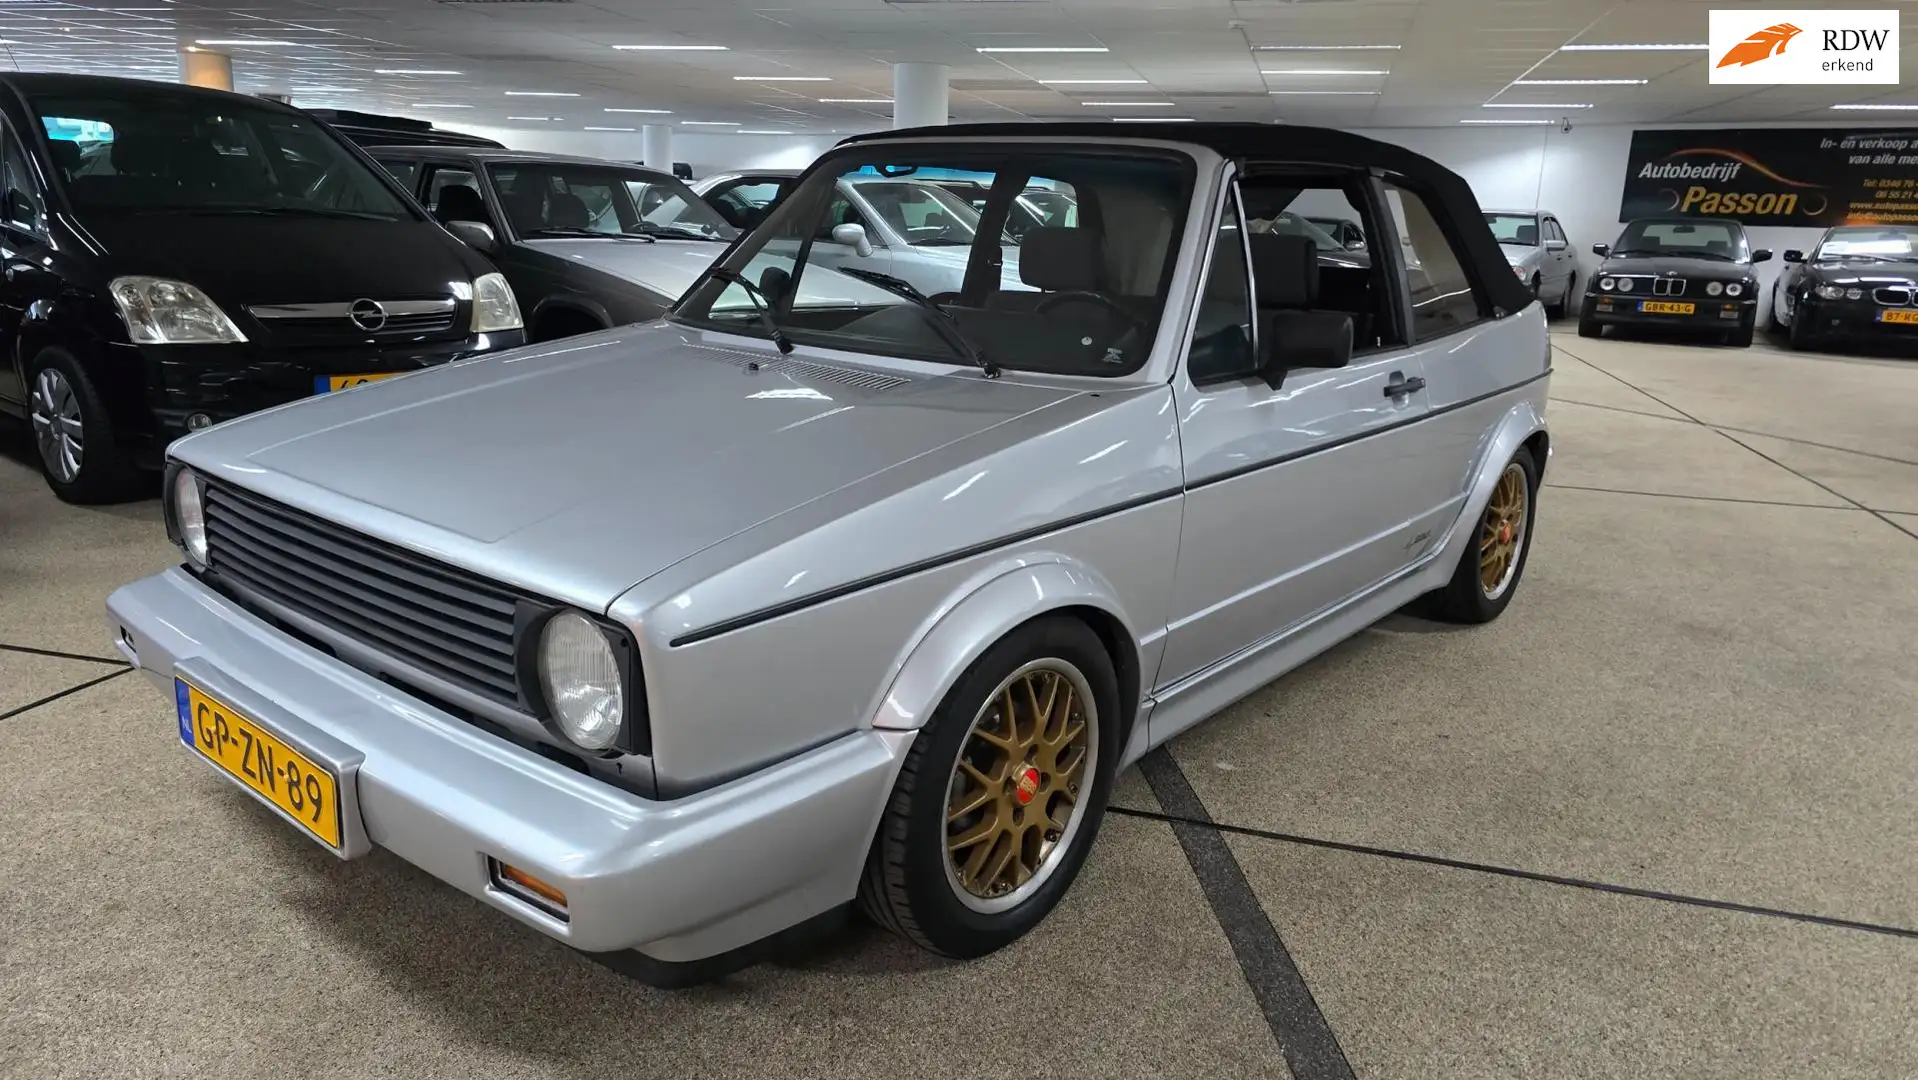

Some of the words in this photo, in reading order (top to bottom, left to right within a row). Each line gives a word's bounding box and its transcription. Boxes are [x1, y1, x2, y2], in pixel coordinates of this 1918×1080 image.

[1840, 139, 1857, 149] en
[1858, 138, 1909, 151] verkoop
[1848, 155, 1872, 165] van
[1872, 153, 1896, 165] alle
[1638, 162, 1742, 183] Autobedrijf
[1680, 186, 1799, 215] Passon
[197, 701, 323, 824] GP-ZN-89
